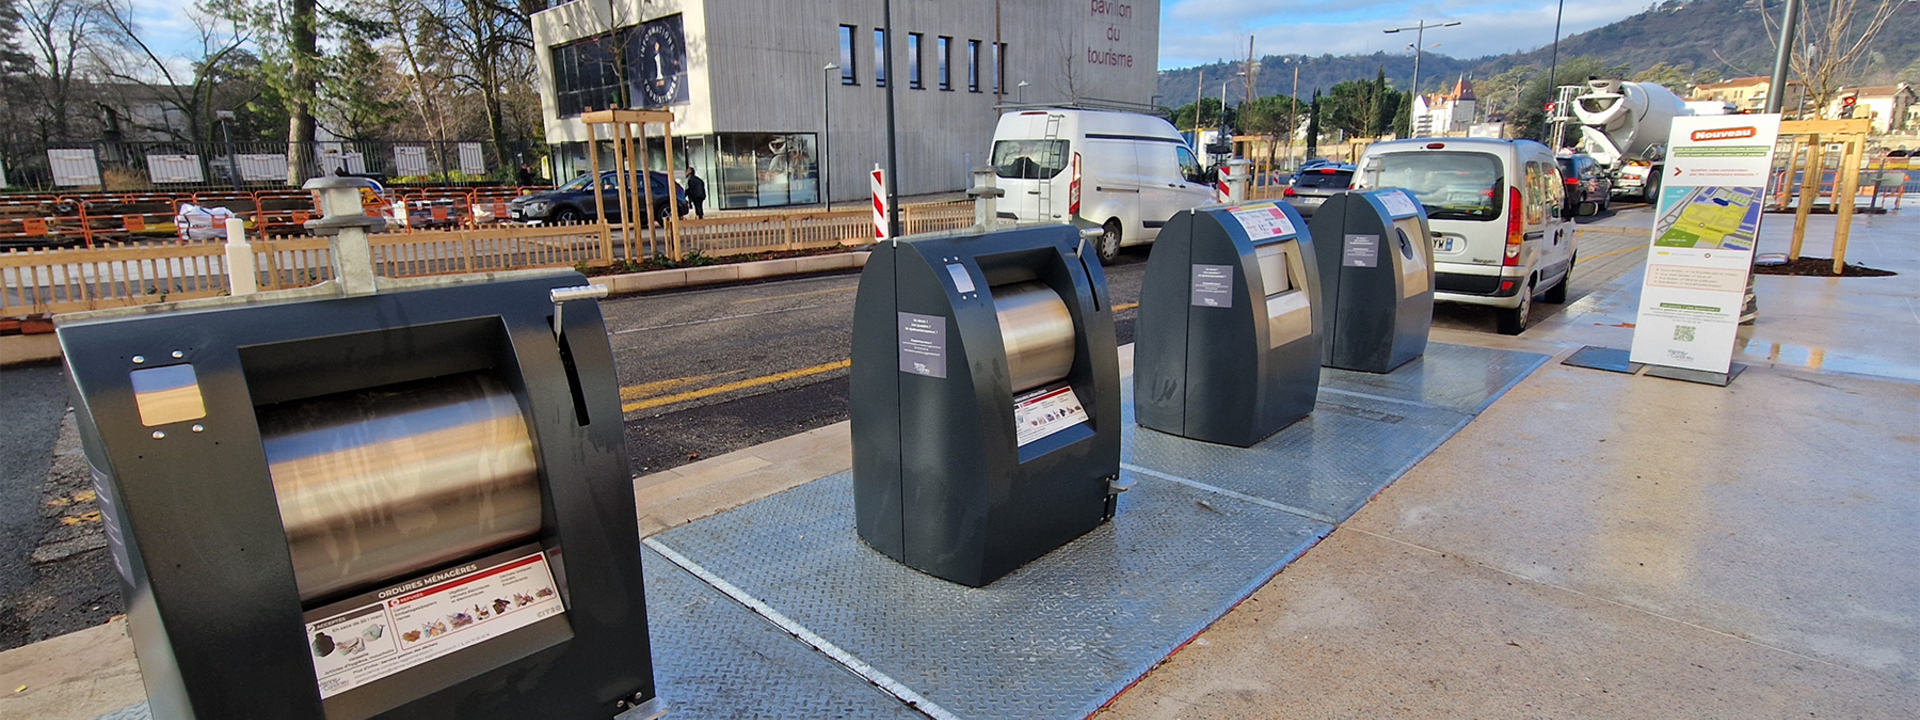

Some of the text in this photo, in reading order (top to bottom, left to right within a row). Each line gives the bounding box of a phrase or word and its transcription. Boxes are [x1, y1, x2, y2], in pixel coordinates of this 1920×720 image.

[1091, 0, 1132, 18] pavillon
[1106, 23, 1120, 41] du
[1087, 46, 1133, 68] tourisme
[1696, 129, 1751, 139] Nouveau
[378, 563, 478, 599] ORDURES MÉNAGÈRES
[399, 592, 424, 603] REFUSÉS
[316, 616, 347, 630] ACCEPTÉS
